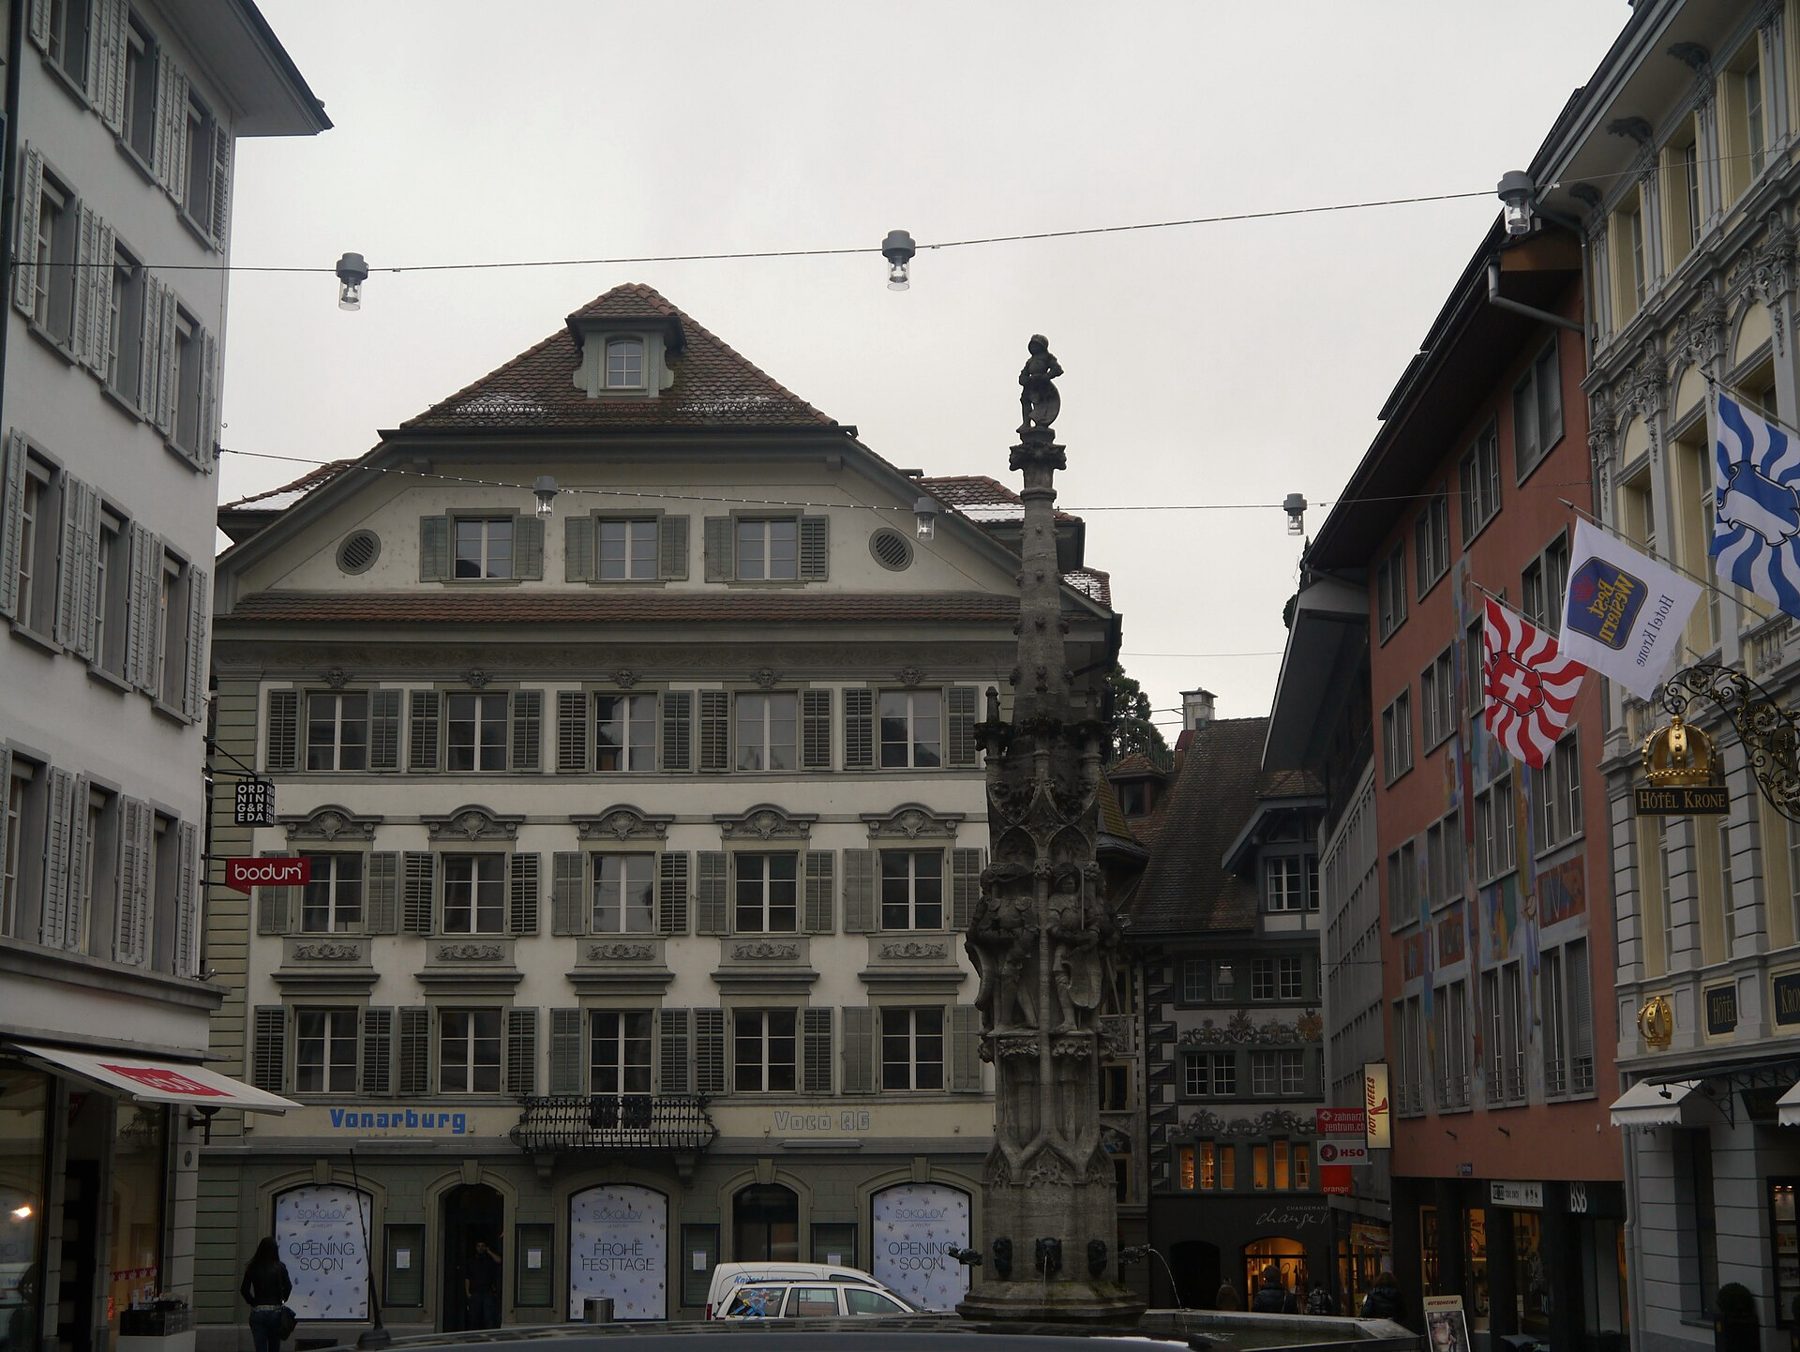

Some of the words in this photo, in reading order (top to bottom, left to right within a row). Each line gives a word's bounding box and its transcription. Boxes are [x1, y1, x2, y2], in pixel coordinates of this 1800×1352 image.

[237, 784, 265, 794] ORD
[237, 794, 265, 803] NIN
[1683, 790, 1726, 809] KRONE
[236, 803, 264, 813] G&R
[237, 812, 264, 822] EDA
[234, 863, 302, 881] bodum
[1780, 983, 1800, 1014] KRO
[1366, 1076, 1376, 1107] HEELS
[330, 1108, 466, 1134] Vonarburg
[774, 1110, 832, 1131] Voco
[840, 1110, 870, 1131] AG
[1368, 1115, 1377, 1136] HOT
[1340, 1148, 1365, 1157] HSO
[1323, 1186, 1349, 1194] orange
[1569, 1181, 1588, 1213] BSB
[896, 1208, 945, 1219] SOKOLOV
[289, 1242, 355, 1256] OPENING
[593, 1242, 643, 1256] FROHE
[299, 1257, 344, 1271] SOON
[582, 1257, 655, 1271] FESTTAGE
[899, 1256, 943, 1270] SOON
